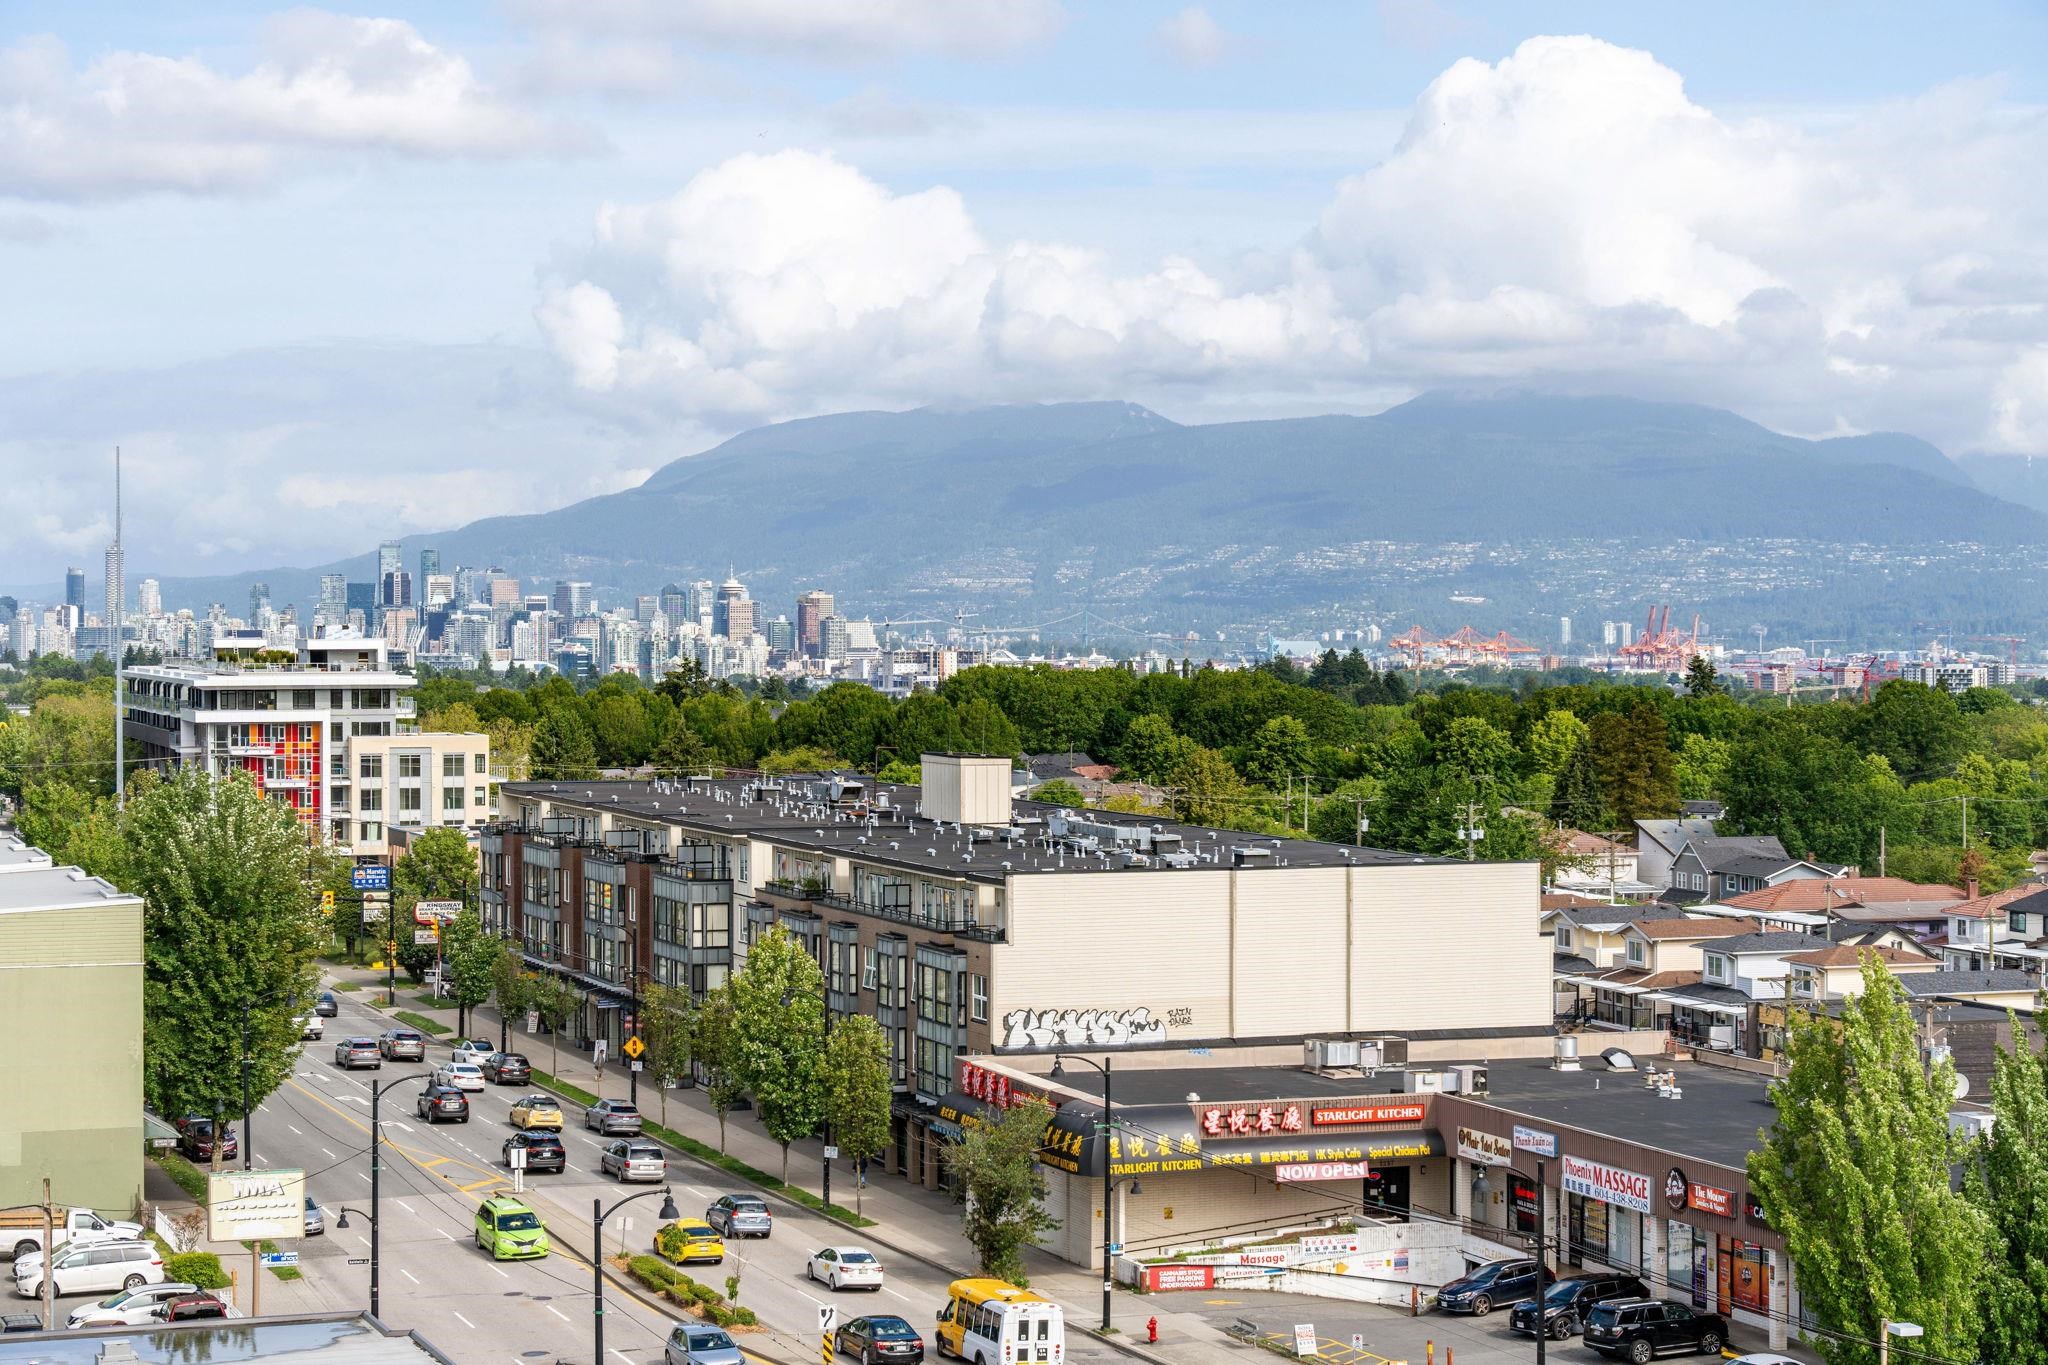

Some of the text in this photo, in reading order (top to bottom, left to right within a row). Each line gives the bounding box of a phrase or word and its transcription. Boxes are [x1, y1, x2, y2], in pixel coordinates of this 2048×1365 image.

[1316, 1107, 1422, 1122] STARLIGHT KITCHEN
[1315, 1144, 1431, 1161] HK Style Cafe Special Chicken Pot
[1465, 1131, 1479, 1149] Hair
[1494, 1138, 1511, 1159] Salon
[1162, 1158, 1202, 1172] KITCHEN
[1279, 1165, 1319, 1180] NOW
[1321, 1162, 1365, 1178] OPEN
[1565, 1157, 1648, 1200] Phoenix MASSAGE
[1594, 1187, 1649, 1211] 604-438-8208
[1240, 1254, 1285, 1265] Massage
[1225, 1269, 1263, 1277] Entrance
